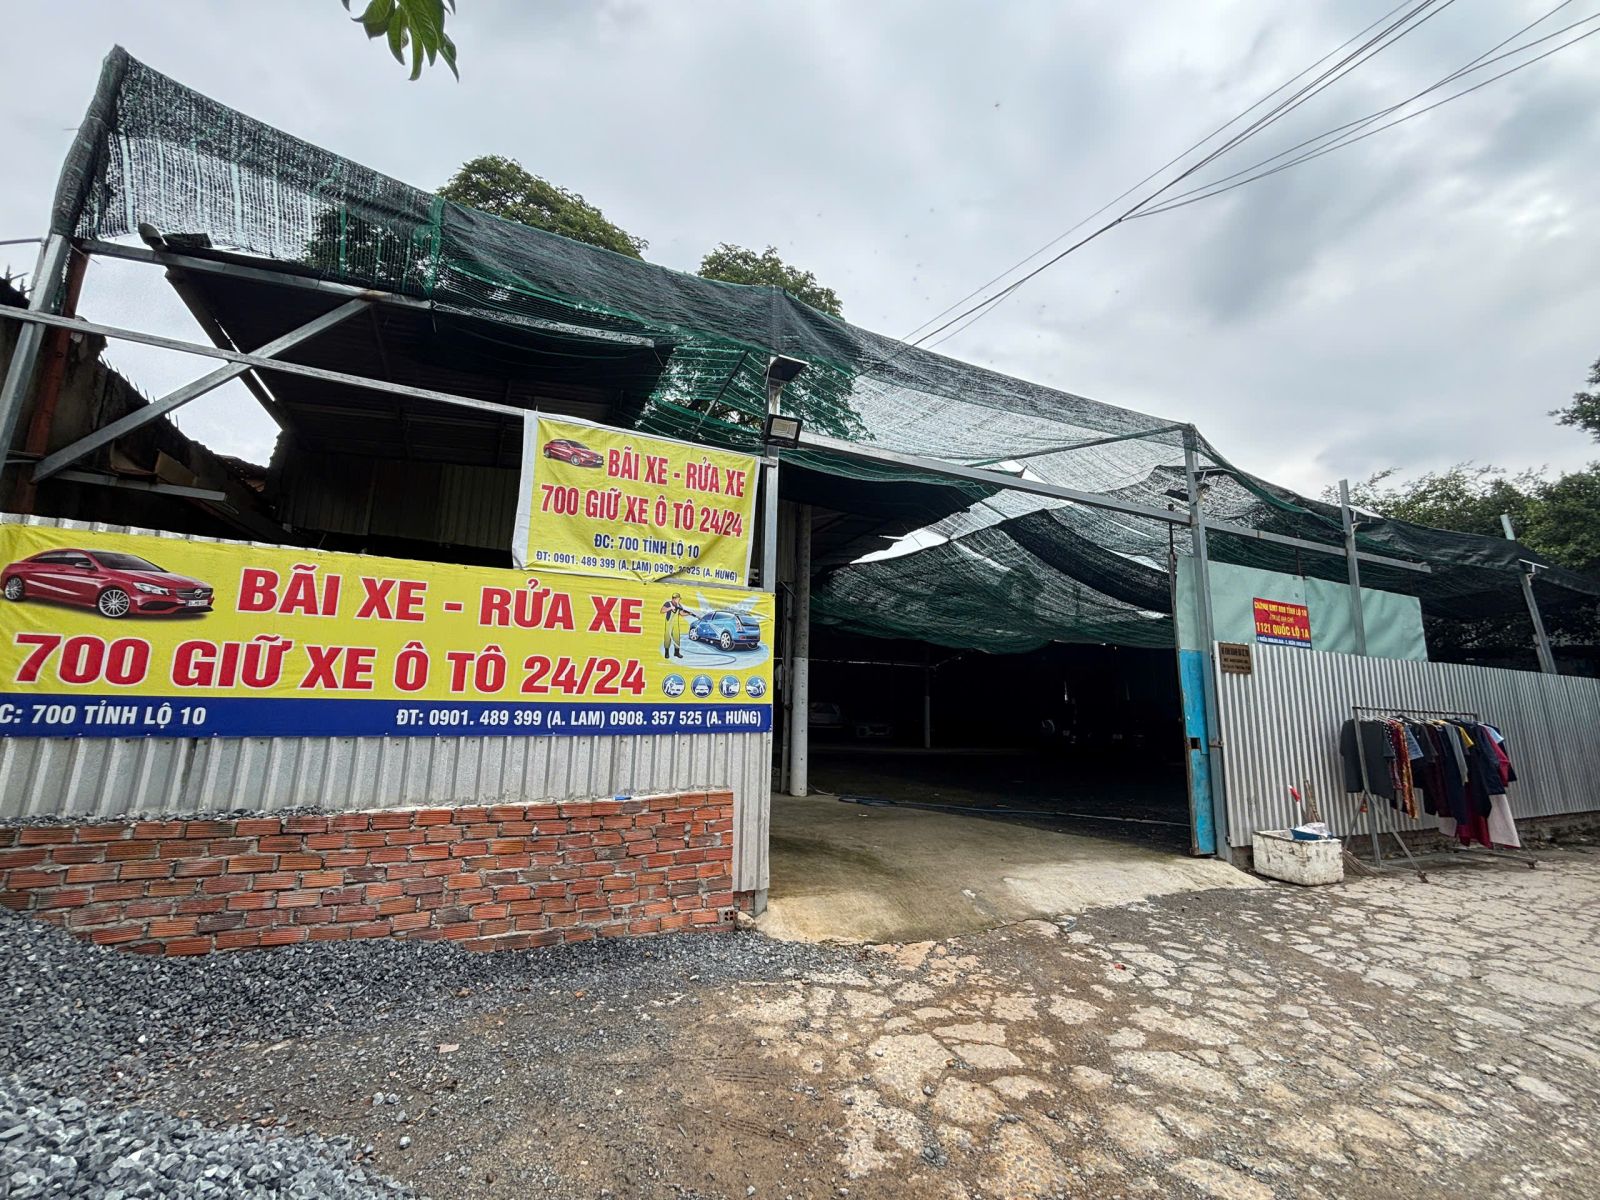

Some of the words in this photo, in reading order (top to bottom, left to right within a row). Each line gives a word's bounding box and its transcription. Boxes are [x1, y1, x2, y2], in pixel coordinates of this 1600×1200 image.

[608, 446, 640, 480] BÃI
[645, 455, 669, 485] XE
[686, 457, 719, 493] RỬA
[725, 469, 746, 497] XE
[541, 484, 579, 515] 700
[585, 488, 621, 520] GIỮ
[624, 495, 649, 524] XE
[655, 495, 667, 527] Ô
[673, 499, 695, 530] TÔ
[699, 507, 743, 537] 24/24
[594, 533, 614, 549] ĐC:
[618, 536, 639, 550] 700
[643, 536, 667, 555] TỈNH
[671, 540, 684, 559] LỘ
[688, 544, 699, 558] 10
[536, 551, 551, 561] ĐT:
[553, 553, 579, 564] 0901.
[581, 556, 597, 567] 489
[600, 558, 616, 569] 399
[618, 560, 629, 571] (A.
[632, 560, 652, 574] LAM)
[703, 568, 713, 578] (A.
[238, 564, 341, 616] BÃI
[356, 577, 428, 621] XE
[444, 602, 463, 612] -
[479, 578, 576, 631] RỬA
[588, 596, 643, 634] XE
[1256, 621, 1271, 634] 1121
[1272, 623, 1291, 636] QUỐC
[1291, 625, 1300, 639] LỘ
[1301, 628, 1310, 639] 1A
[14, 633, 151, 686] 700
[171, 634, 293, 688] GIỮ
[299, 645, 376, 690] XE
[394, 641, 430, 692] Ô
[447, 644, 508, 693] TÔ
[520, 655, 646, 695] 24/24
[32, 704, 76, 725] 700
[85, 700, 136, 725] TỈNH
[144, 702, 172, 730] LỘ
[181, 706, 206, 725] 10
[396, 709, 424, 725] ĐT:
[429, 709, 474, 725] 0901.
[480, 710, 509, 726] 489
[514, 710, 542, 726] 399
[547, 710, 566, 728] (A.
[571, 711, 605, 728] LAM)
[610, 711, 647, 725] 0908.
[651, 711, 675, 725] 357
[679, 711, 702, 725] 525
[706, 711, 722, 727] (A.
[725, 709, 761, 727] HƯNG)
